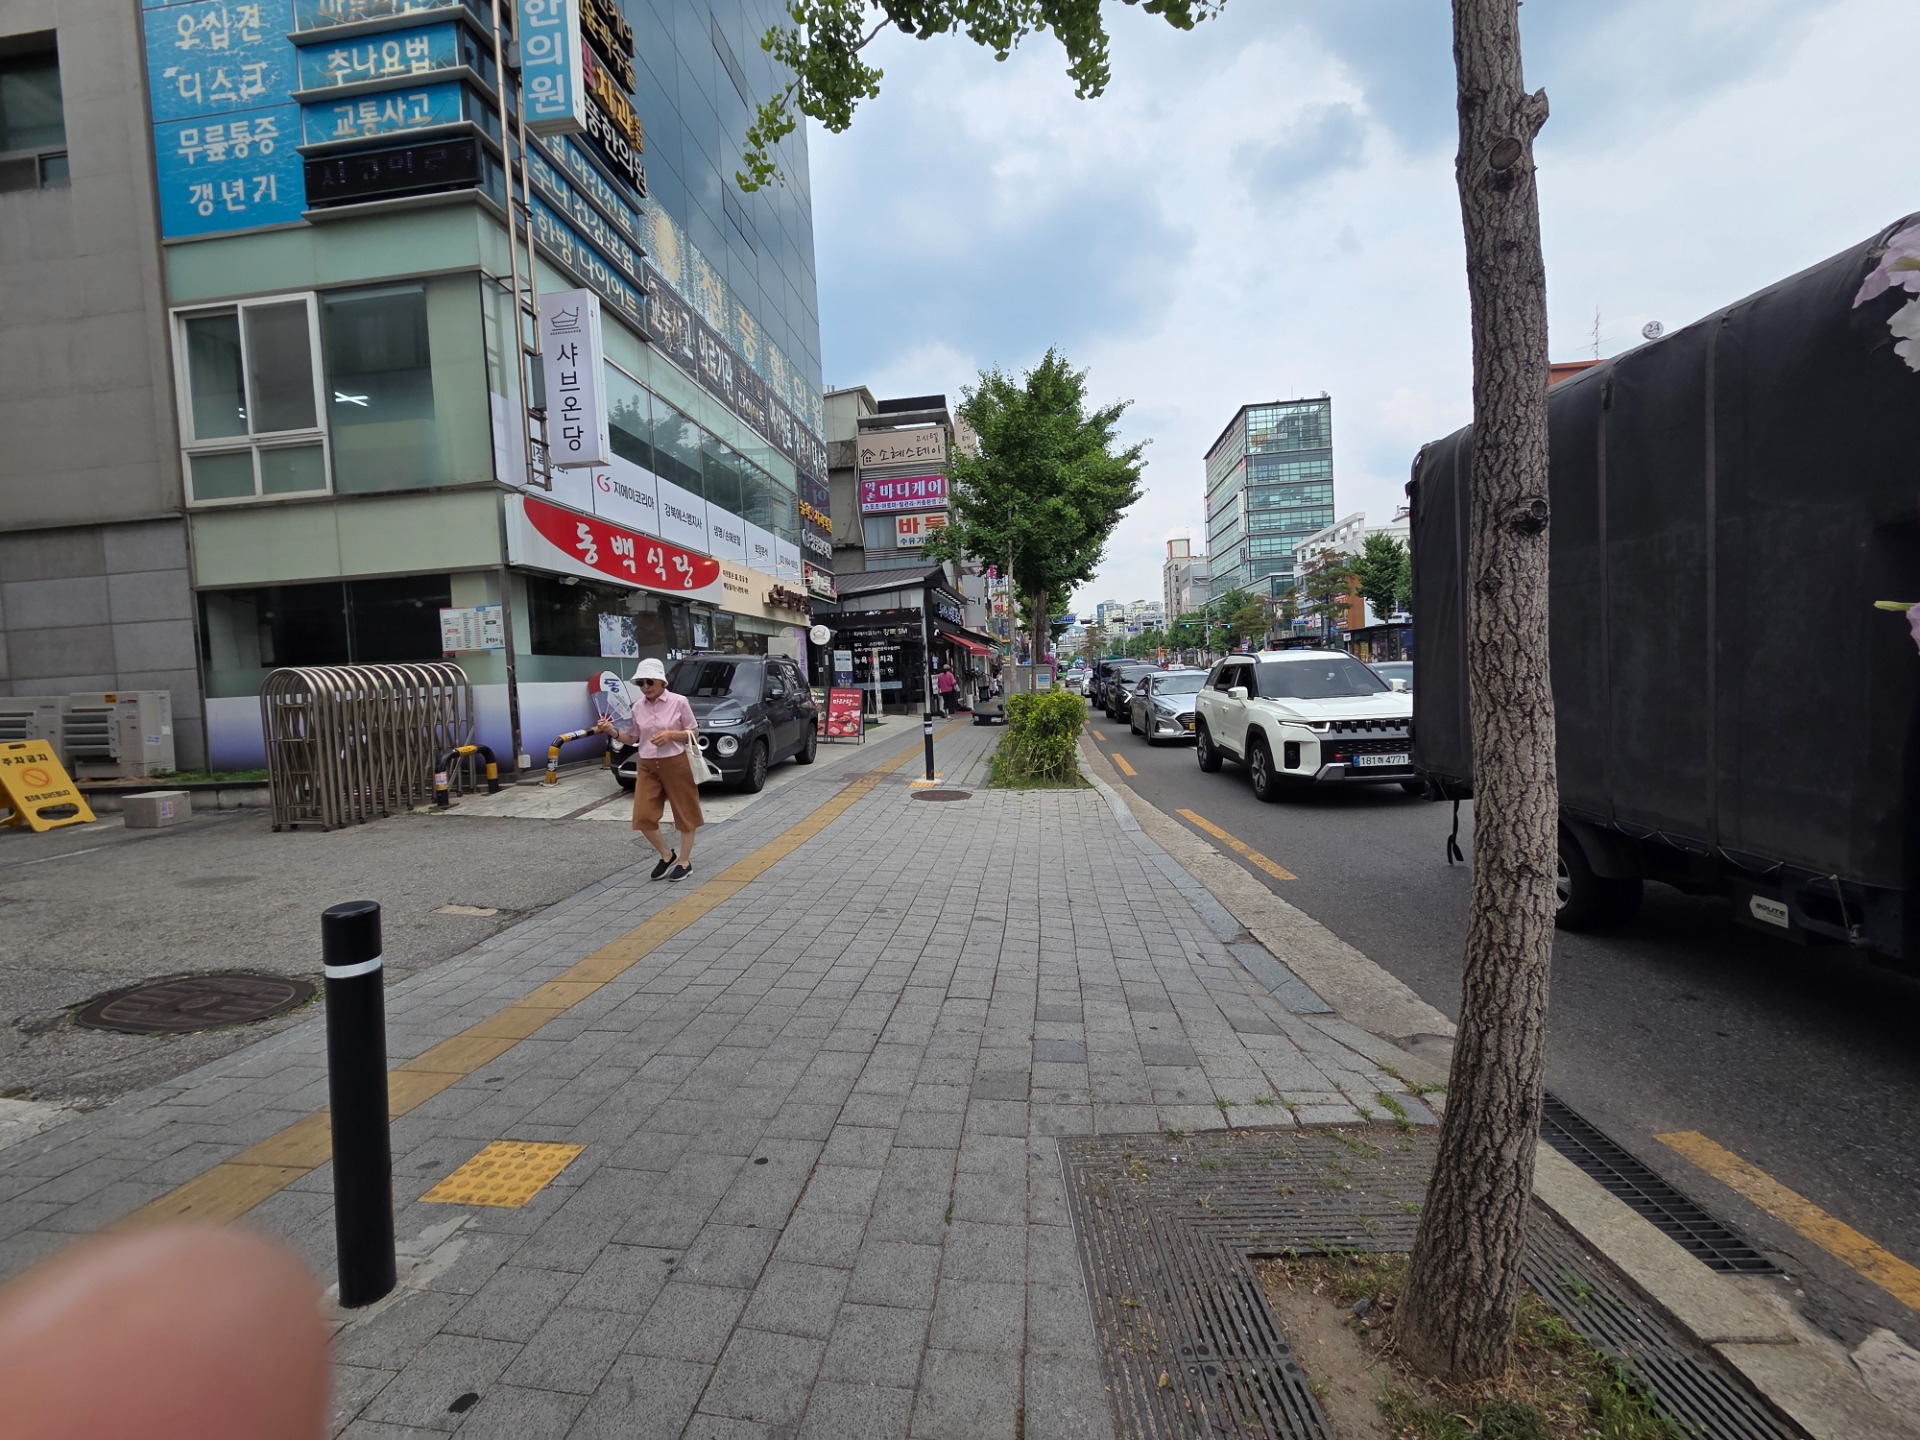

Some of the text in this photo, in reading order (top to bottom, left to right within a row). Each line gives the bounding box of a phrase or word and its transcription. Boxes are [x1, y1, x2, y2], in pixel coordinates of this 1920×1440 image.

[175, 4, 262, 50] 오십견
[327, 36, 430, 86] 추나요법
[524, 0, 567, 114] 한의원
[177, 63, 268, 104] 디스크
[332, 94, 433, 137] 교통사고
[177, 116, 280, 165] 무릎통증
[189, 174, 278, 216] 갱년기
[533, 151, 570, 212] 추나
[570, 148, 634, 234] 야간진료
[535, 207, 640, 319] 한방 다이어트
[555, 342, 585, 452] 샤브온당
[879, 444, 941, 461] 소혜스테이
[916, 432, 939, 443] 고시텔
[612, 480, 655, 510] 지에이코리아
[879, 478, 943, 499] 바디케어
[575, 521, 694, 588] 동백식당
[855, 666, 895, 680] 청풍의원
[1, 753, 48, 766] 주차금지
